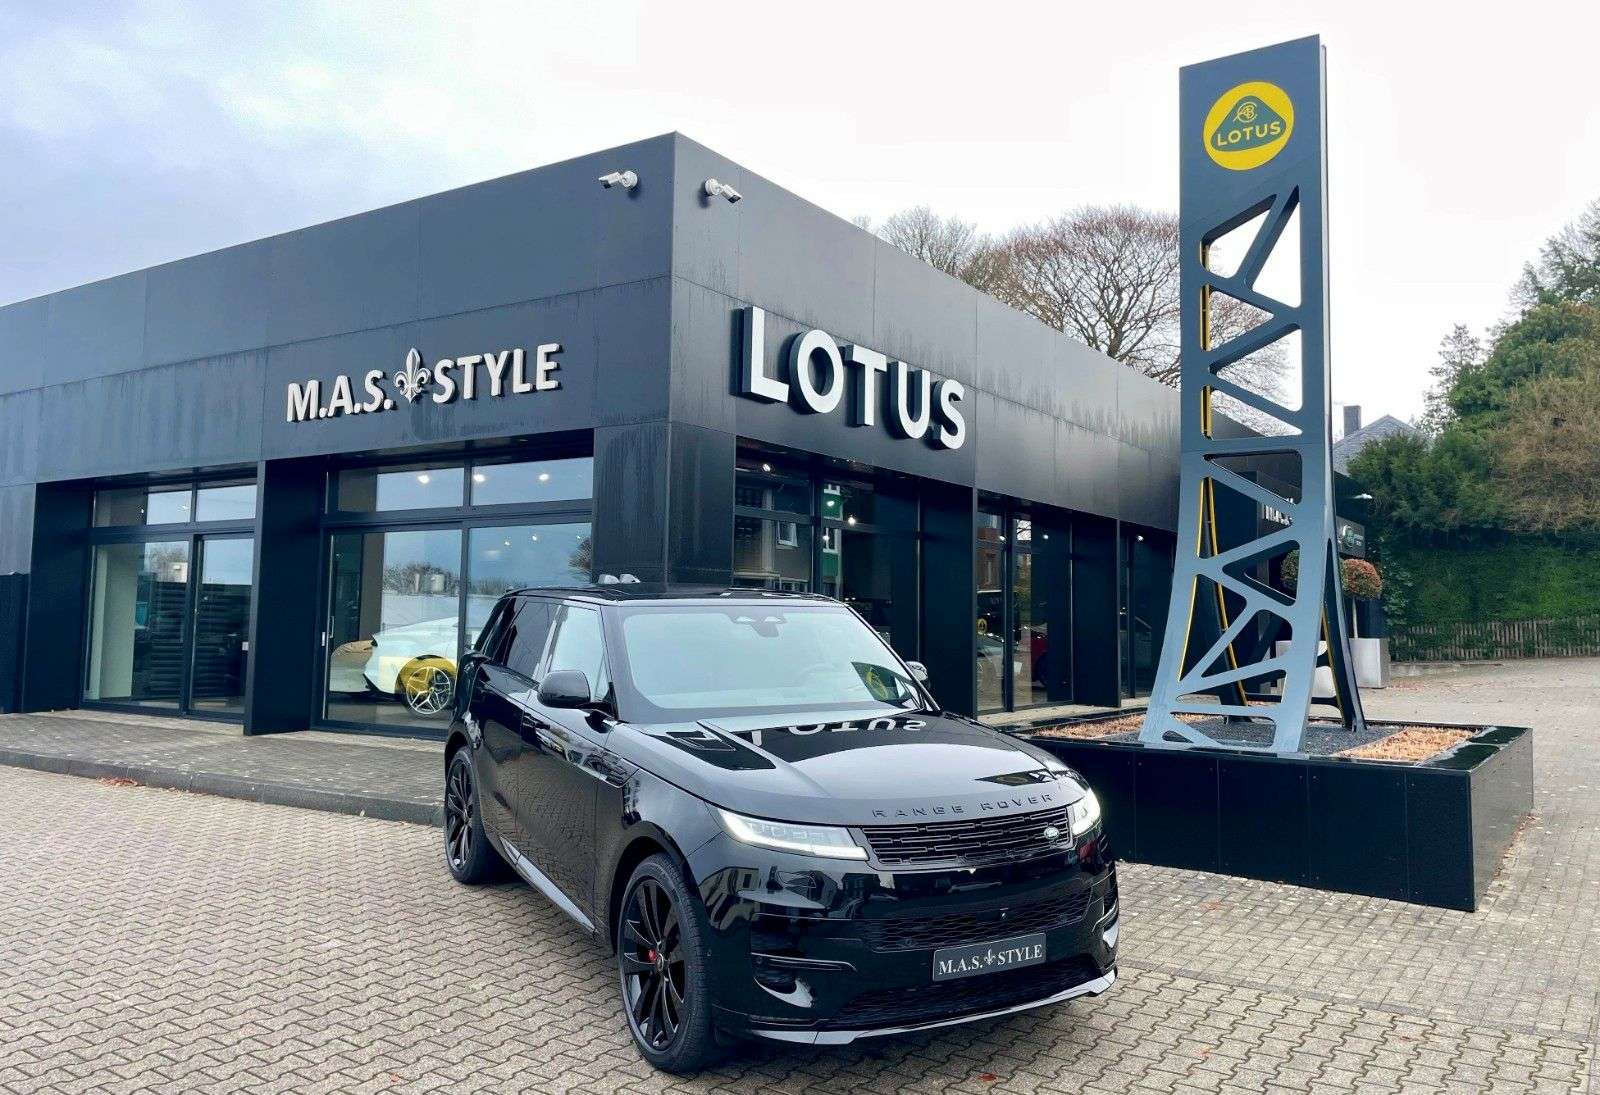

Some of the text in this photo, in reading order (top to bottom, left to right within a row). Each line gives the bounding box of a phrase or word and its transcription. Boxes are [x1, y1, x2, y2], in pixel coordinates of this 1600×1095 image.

[1217, 121, 1280, 147] LOTUS
[287, 343, 560, 422] M.A.S. STYLE
[742, 306, 966, 450] LOTUS
[872, 794, 1052, 818] RANGE ROVER
[938, 944, 1043, 975] M.A.S. STYLE
